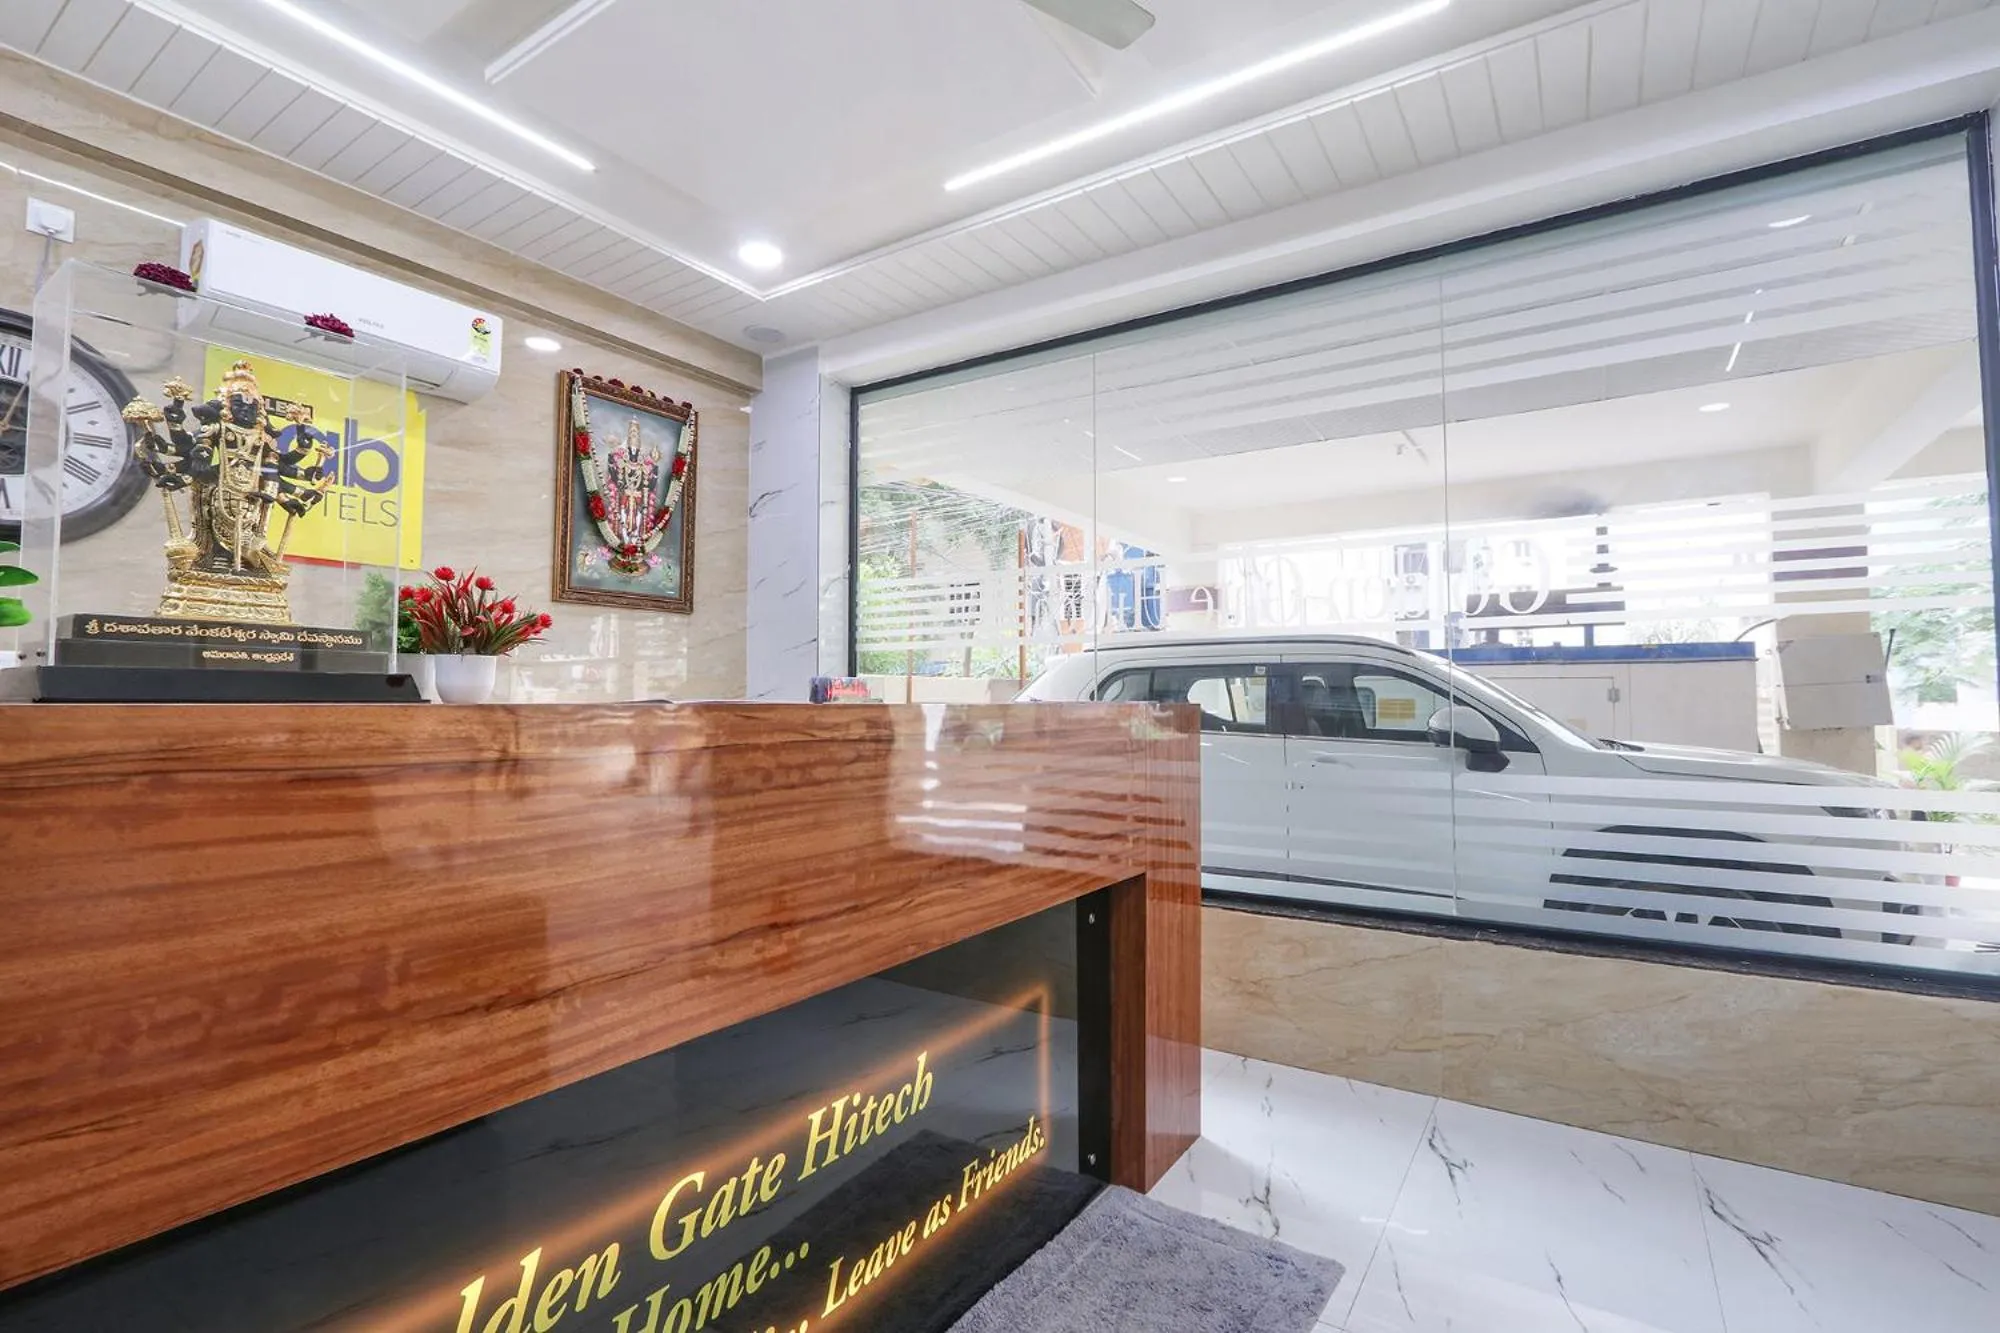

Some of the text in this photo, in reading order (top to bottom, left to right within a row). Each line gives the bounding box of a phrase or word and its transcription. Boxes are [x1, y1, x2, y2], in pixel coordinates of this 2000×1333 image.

[276, 417, 400, 494] ab
[322, 490, 399, 528] TELS
[456, 1050, 934, 1333] lden Gate Hitech
[821, 1114, 1046, 1319] Leave as Friends.
